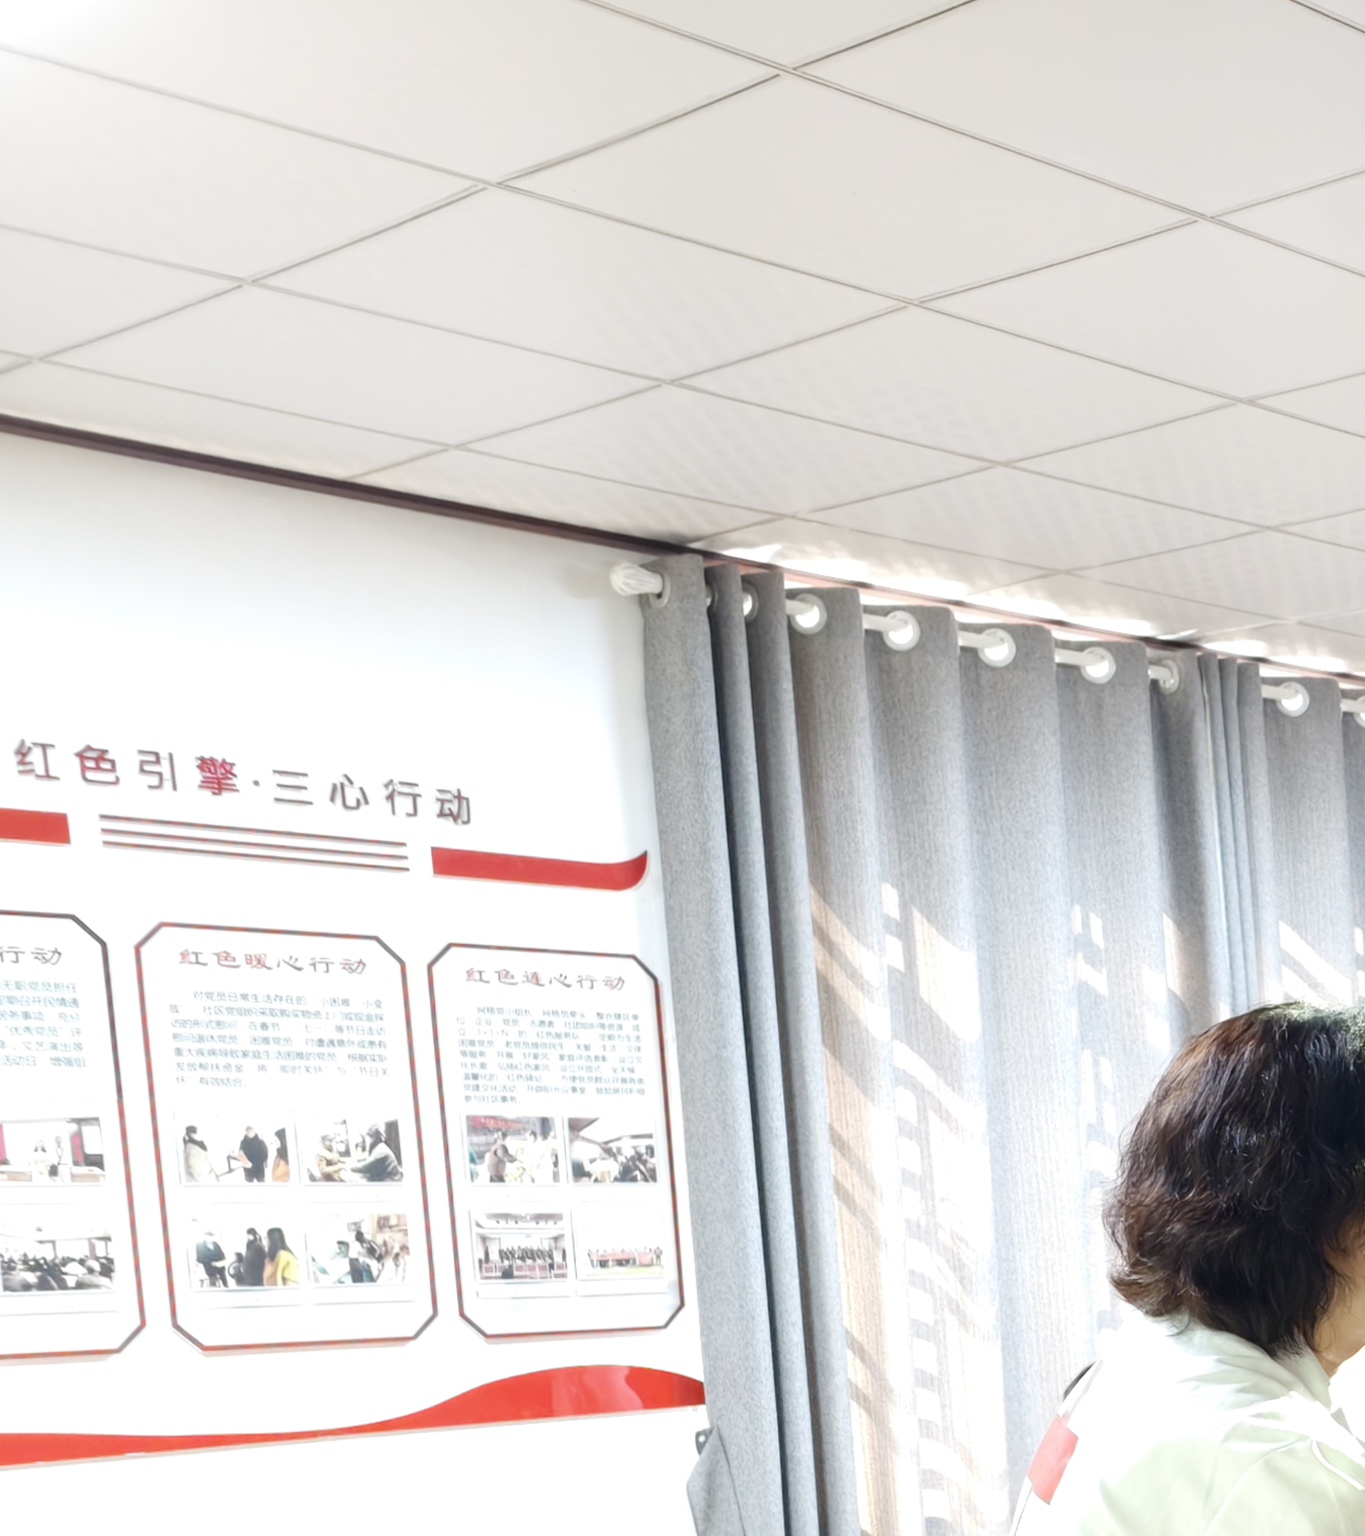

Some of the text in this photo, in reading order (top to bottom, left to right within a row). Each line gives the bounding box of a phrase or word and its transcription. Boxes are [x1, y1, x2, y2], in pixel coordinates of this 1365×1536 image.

[178, 947, 368, 974] 红色暖心行动
[464, 966, 626, 992] 红色连心行动
